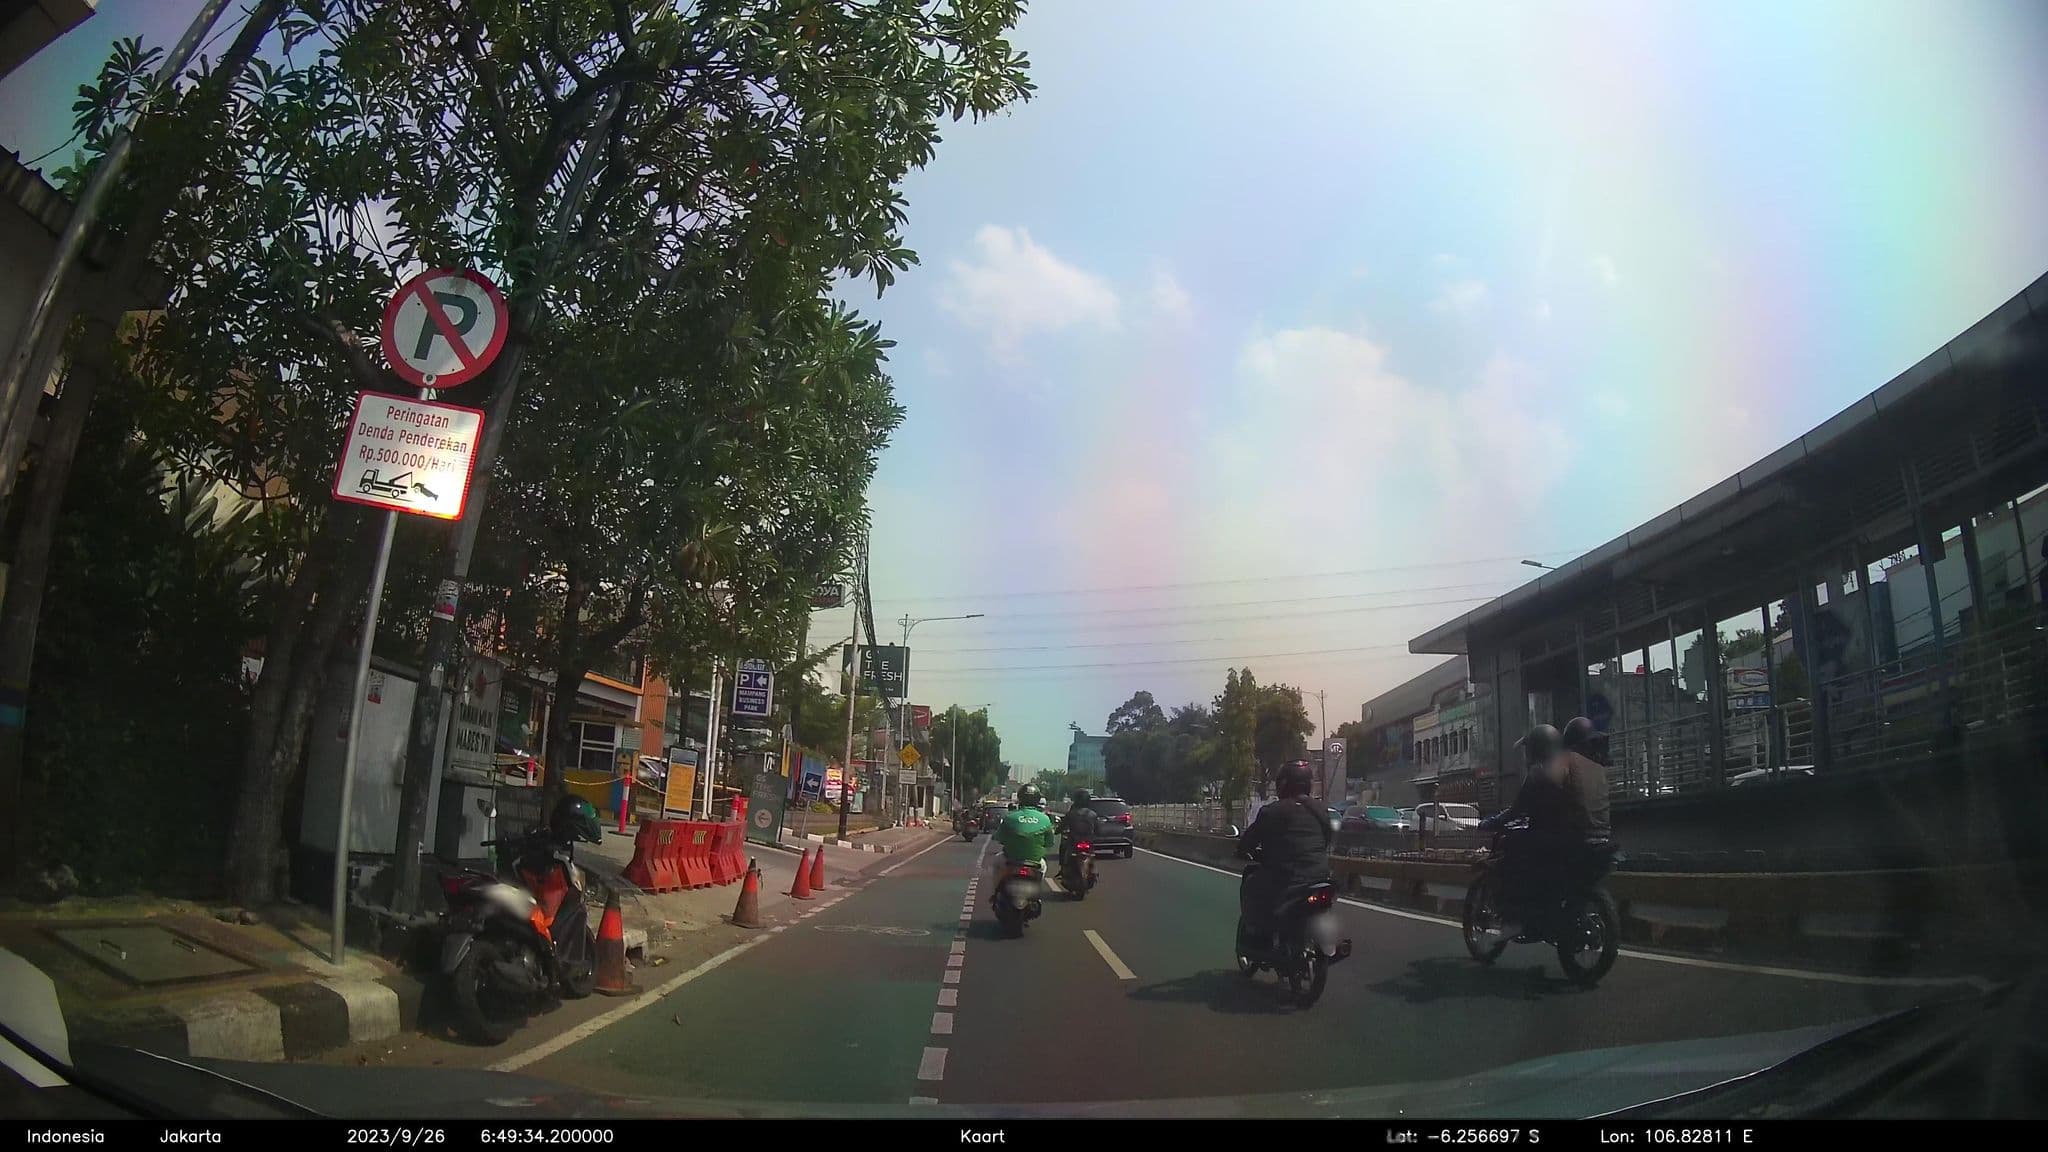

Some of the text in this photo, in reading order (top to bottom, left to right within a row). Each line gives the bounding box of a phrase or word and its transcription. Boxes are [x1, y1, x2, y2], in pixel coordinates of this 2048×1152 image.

[413, 290, 478, 361] P
[386, 405, 449, 429] Peringatan
[358, 422, 467, 453] Denda Penderekan
[359, 444, 456, 473] Rp.500.000/Hari
[814, 586, 839, 597] OYA
[865, 660, 889, 671] TE
[739, 673, 750, 686] P
[738, 697, 765, 705] BUSINESS
[743, 704, 758, 712] PARK
[456, 728, 480, 753] MABES
[1018, 815, 1039, 824] Grab
